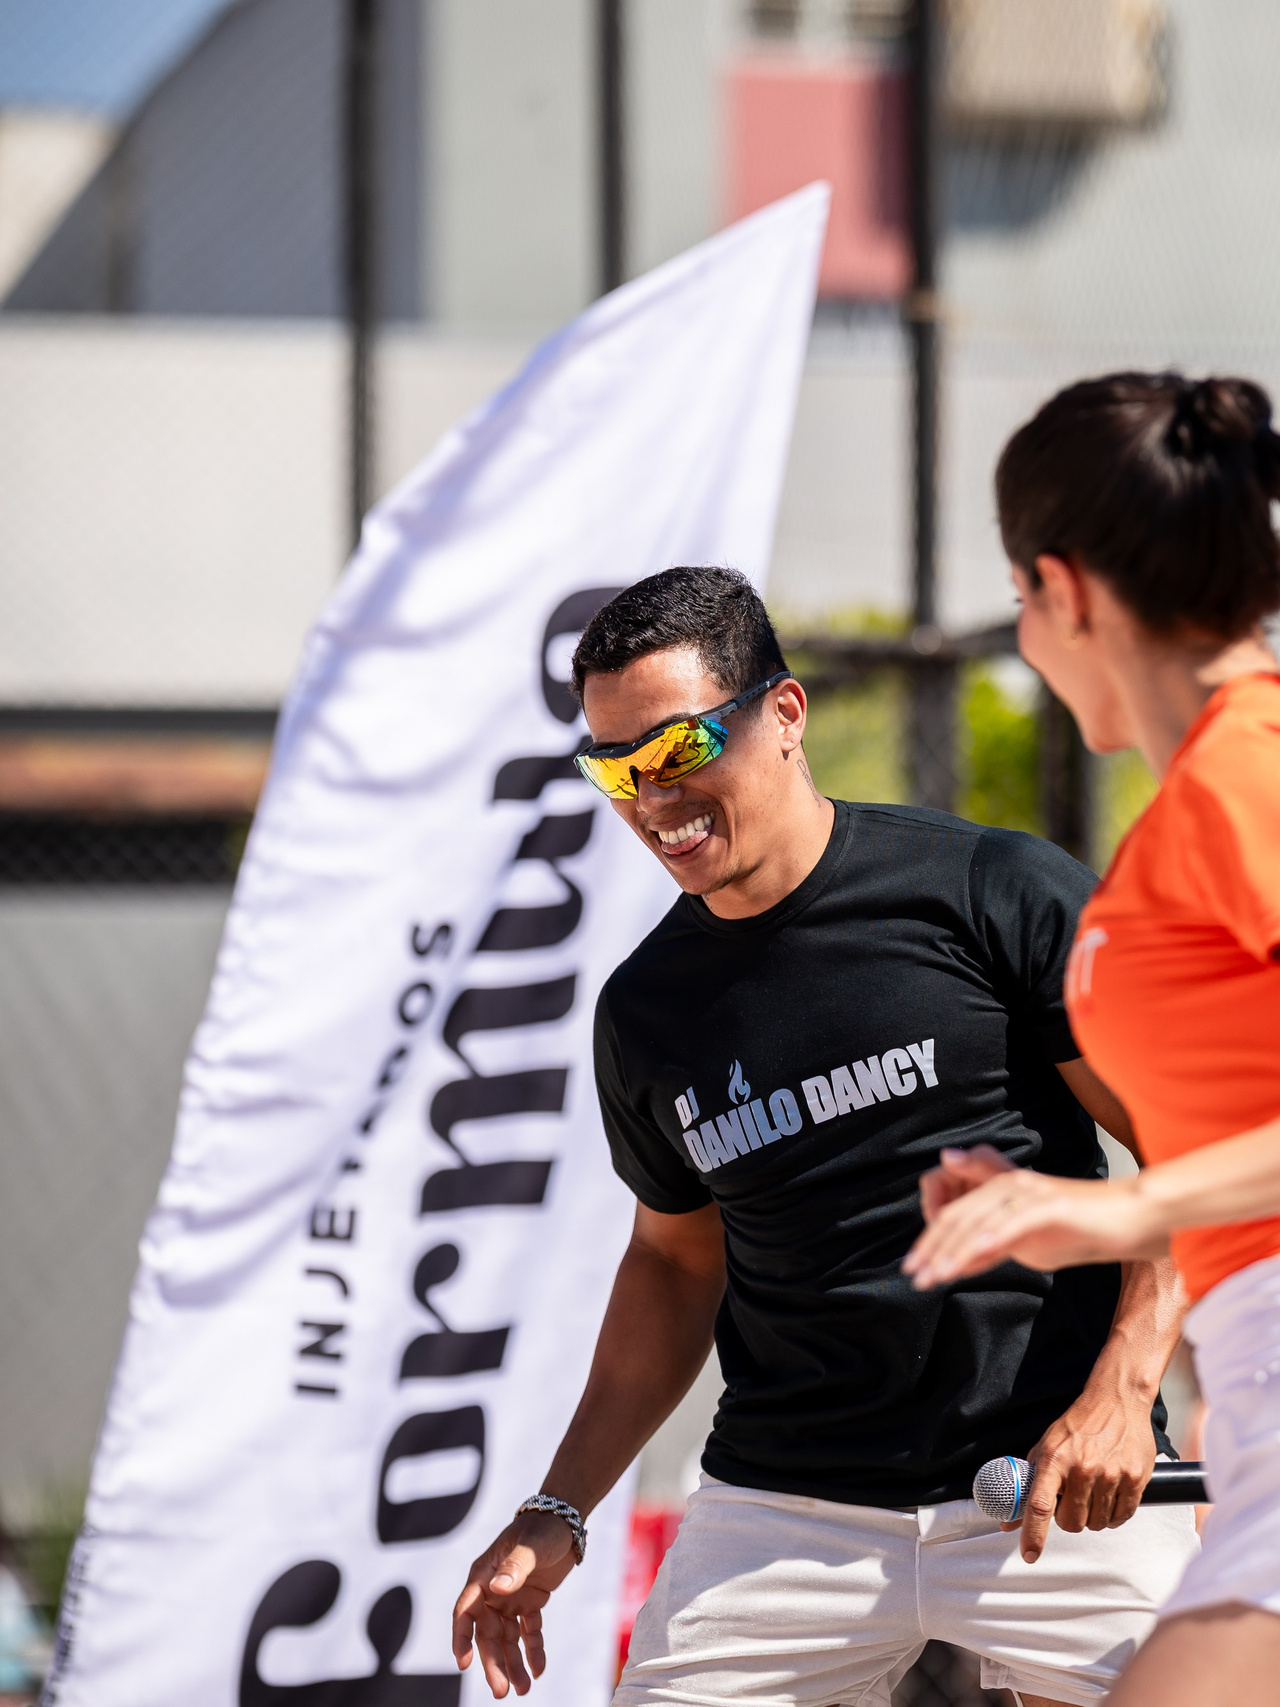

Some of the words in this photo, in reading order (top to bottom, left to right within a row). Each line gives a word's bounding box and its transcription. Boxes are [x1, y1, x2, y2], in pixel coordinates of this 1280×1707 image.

[674, 1086, 700, 1130] DJ
[682, 1088, 803, 1174] DANILO
[801, 1038, 939, 1125] DANCY
